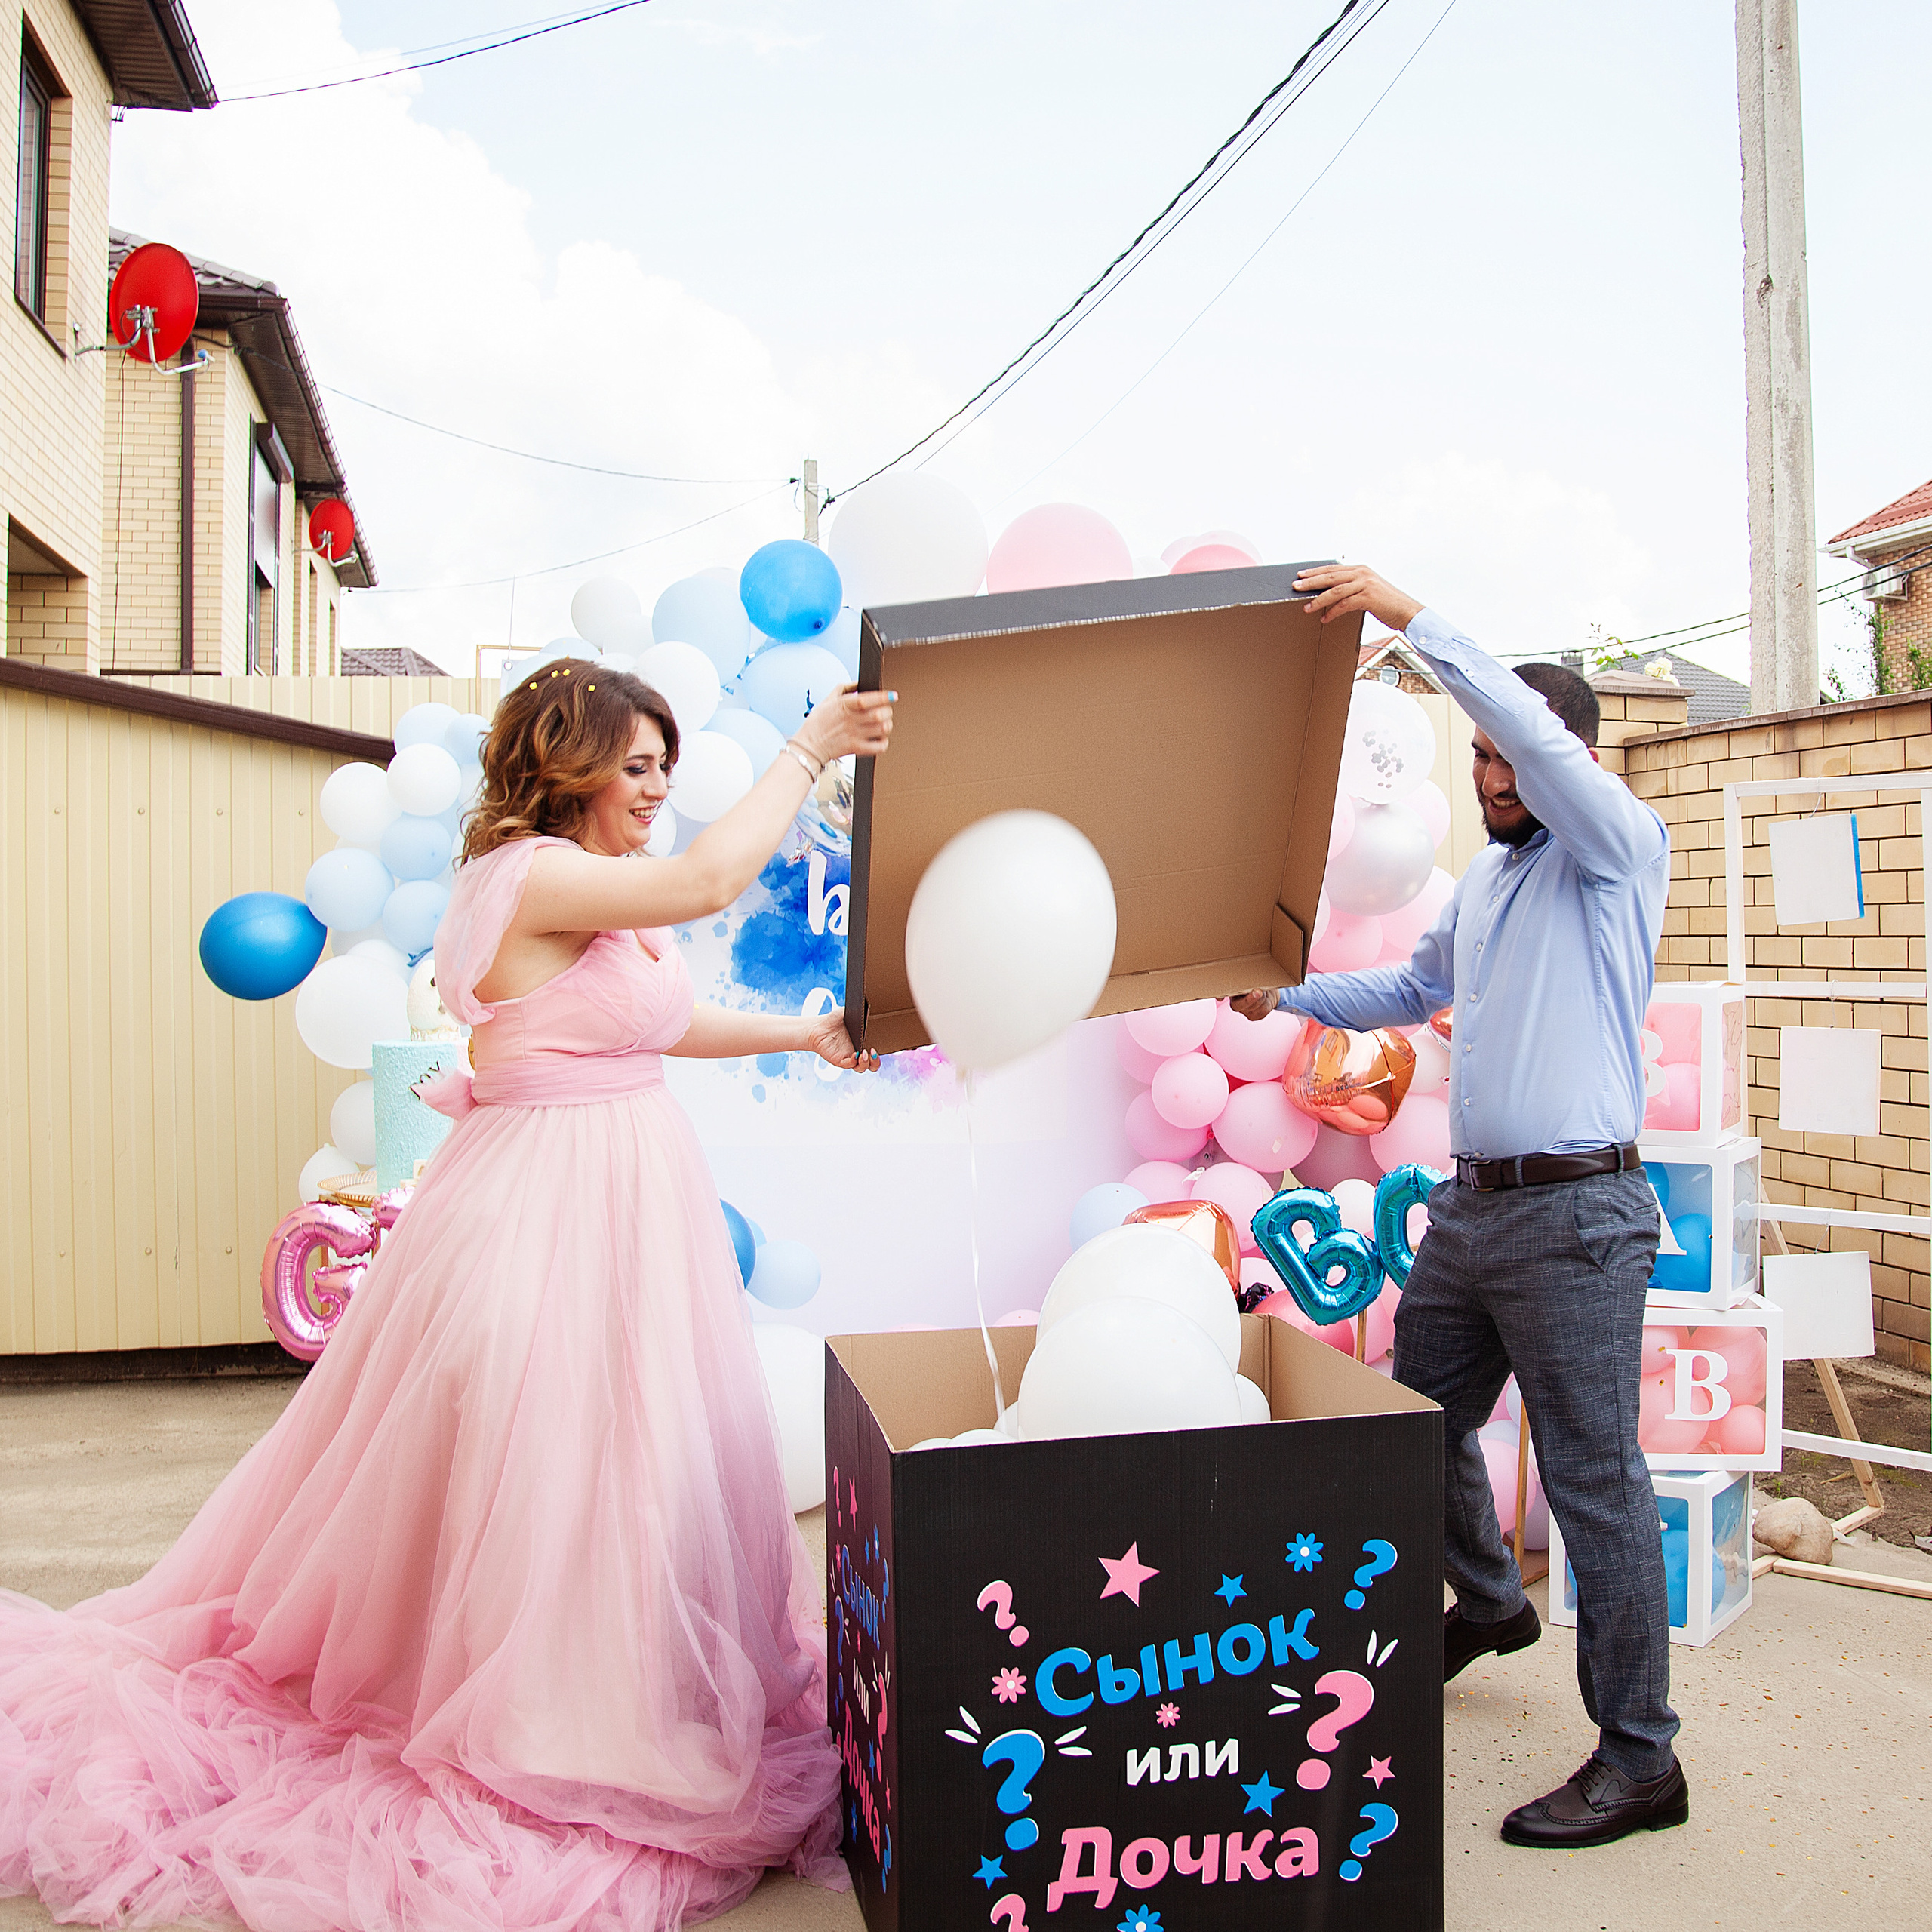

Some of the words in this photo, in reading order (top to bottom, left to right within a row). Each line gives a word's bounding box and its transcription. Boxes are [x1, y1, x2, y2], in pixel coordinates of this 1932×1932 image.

[1664, 1349, 1733, 1422] B
[841, 1543, 881, 1651] Сынок
[1035, 1607, 1320, 1717] Сынок
[842, 1700, 881, 1864] Дочка
[1126, 1738, 1239, 1786] или
[1046, 1825, 1320, 1912] Дочка
